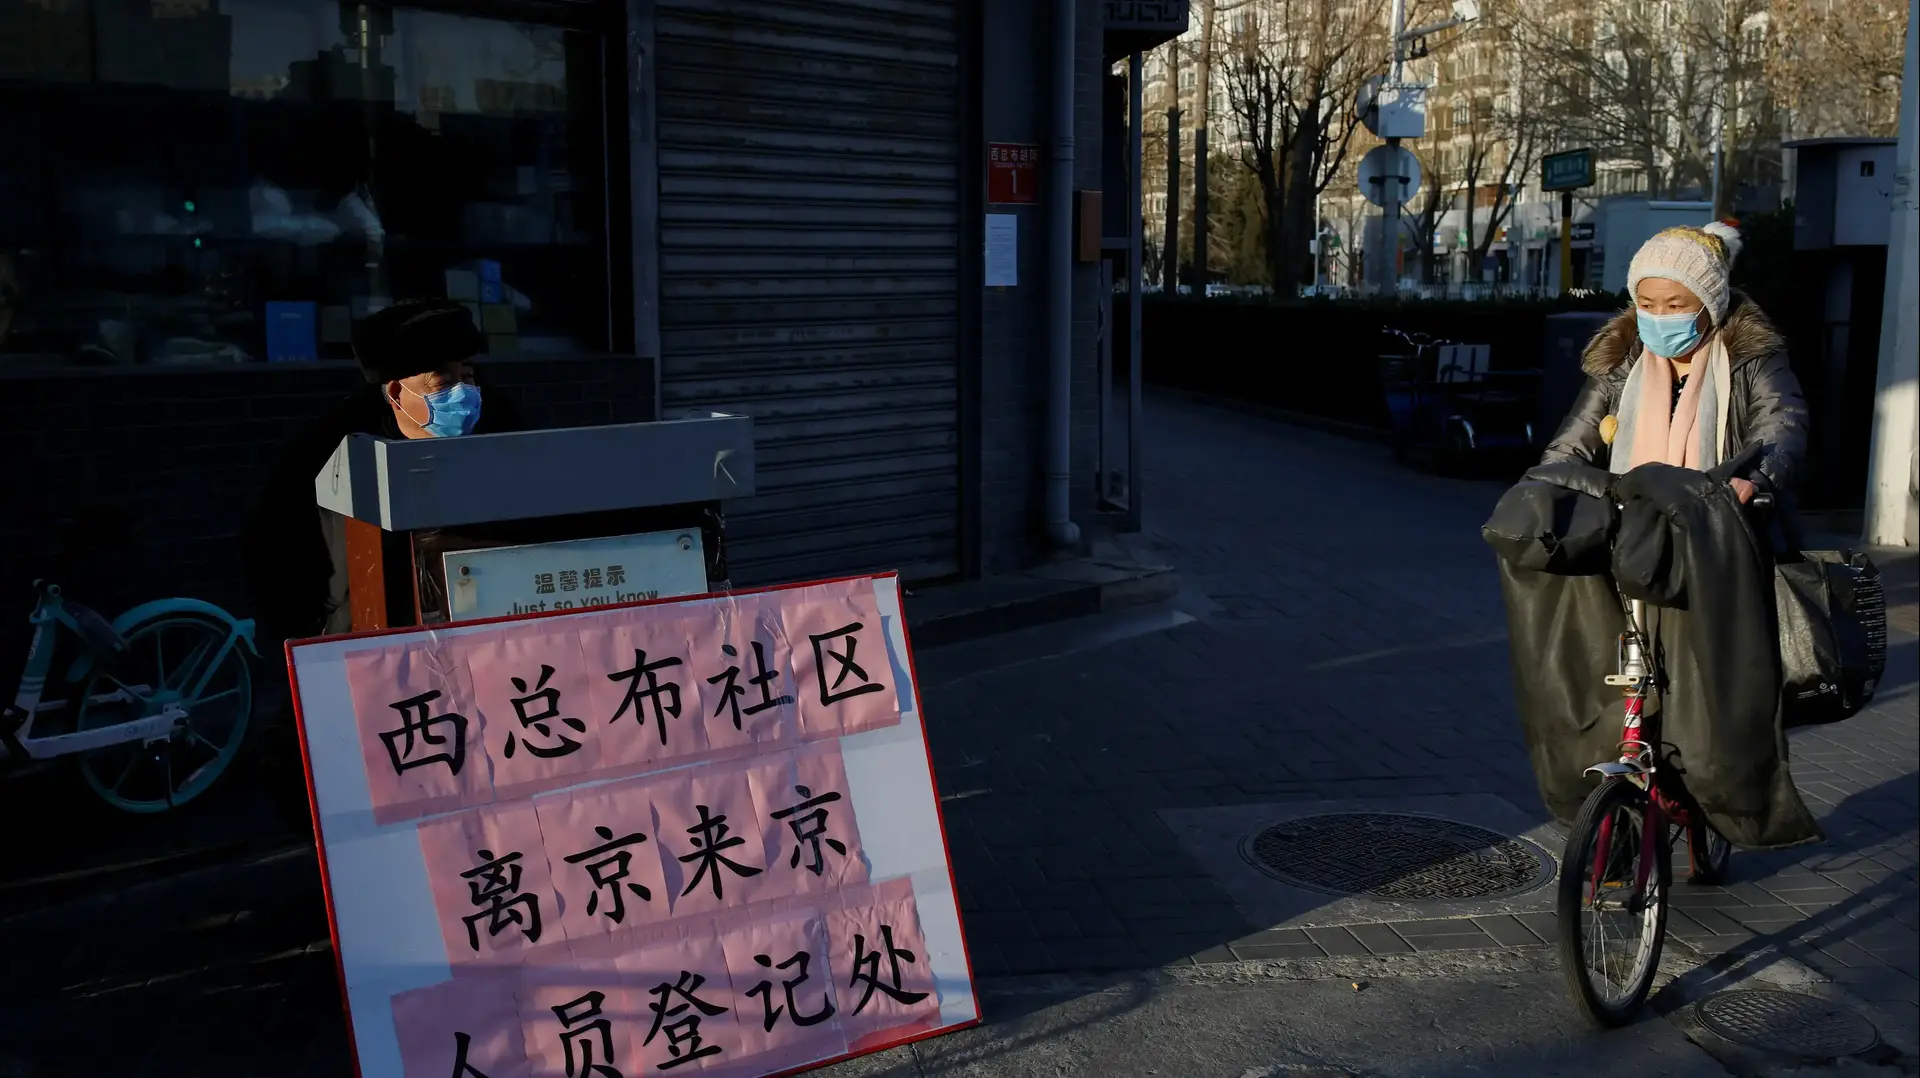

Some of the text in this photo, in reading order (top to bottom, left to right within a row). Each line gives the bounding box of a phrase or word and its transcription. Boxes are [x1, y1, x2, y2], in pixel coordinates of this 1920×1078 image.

[1010, 169, 1018, 194] 1
[534, 564, 626, 595] 温馨提示
[506, 601, 546, 615] Just
[553, 600, 574, 611] so
[616, 589, 659, 604] know
[379, 621, 885, 777] 西总布社区
[459, 785, 847, 952] 离京来京
